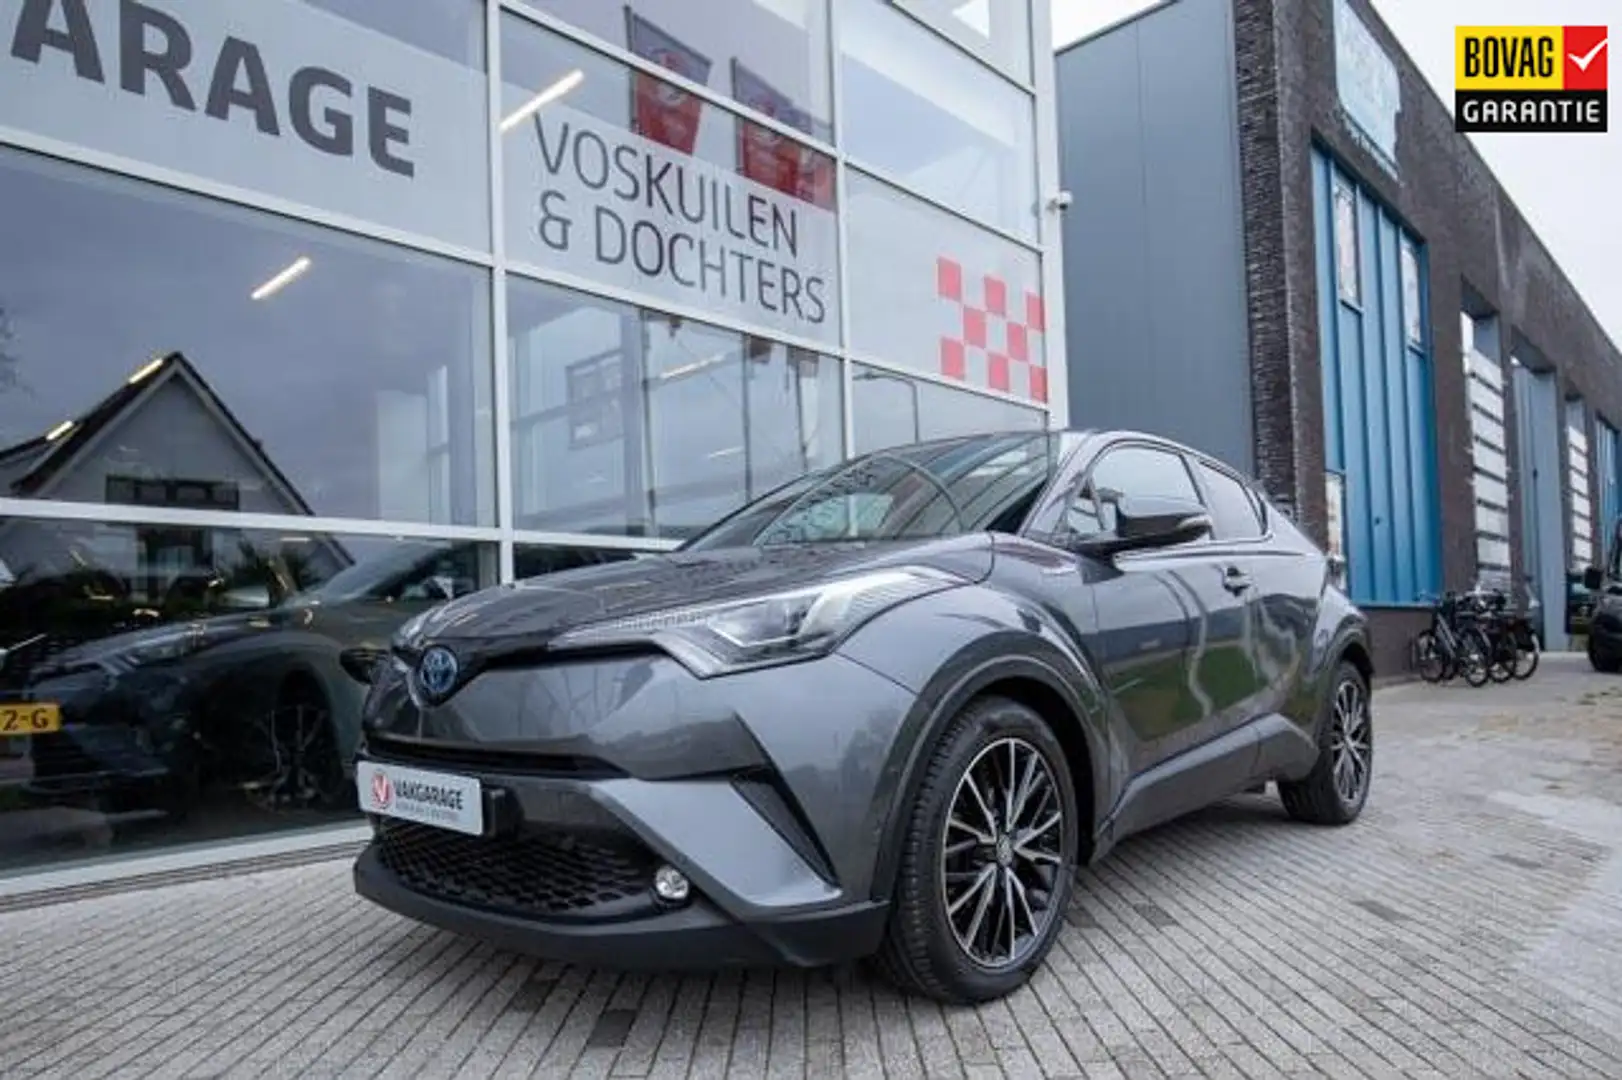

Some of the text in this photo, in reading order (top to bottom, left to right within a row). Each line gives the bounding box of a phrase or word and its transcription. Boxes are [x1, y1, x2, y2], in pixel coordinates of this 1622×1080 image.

[11, 0, 415, 178] ARAGE
[534, 112, 797, 258] VOSKUILEN
[538, 190, 825, 325] & DOCHTERS
[394, 780, 464, 811] VAKGARAGE
